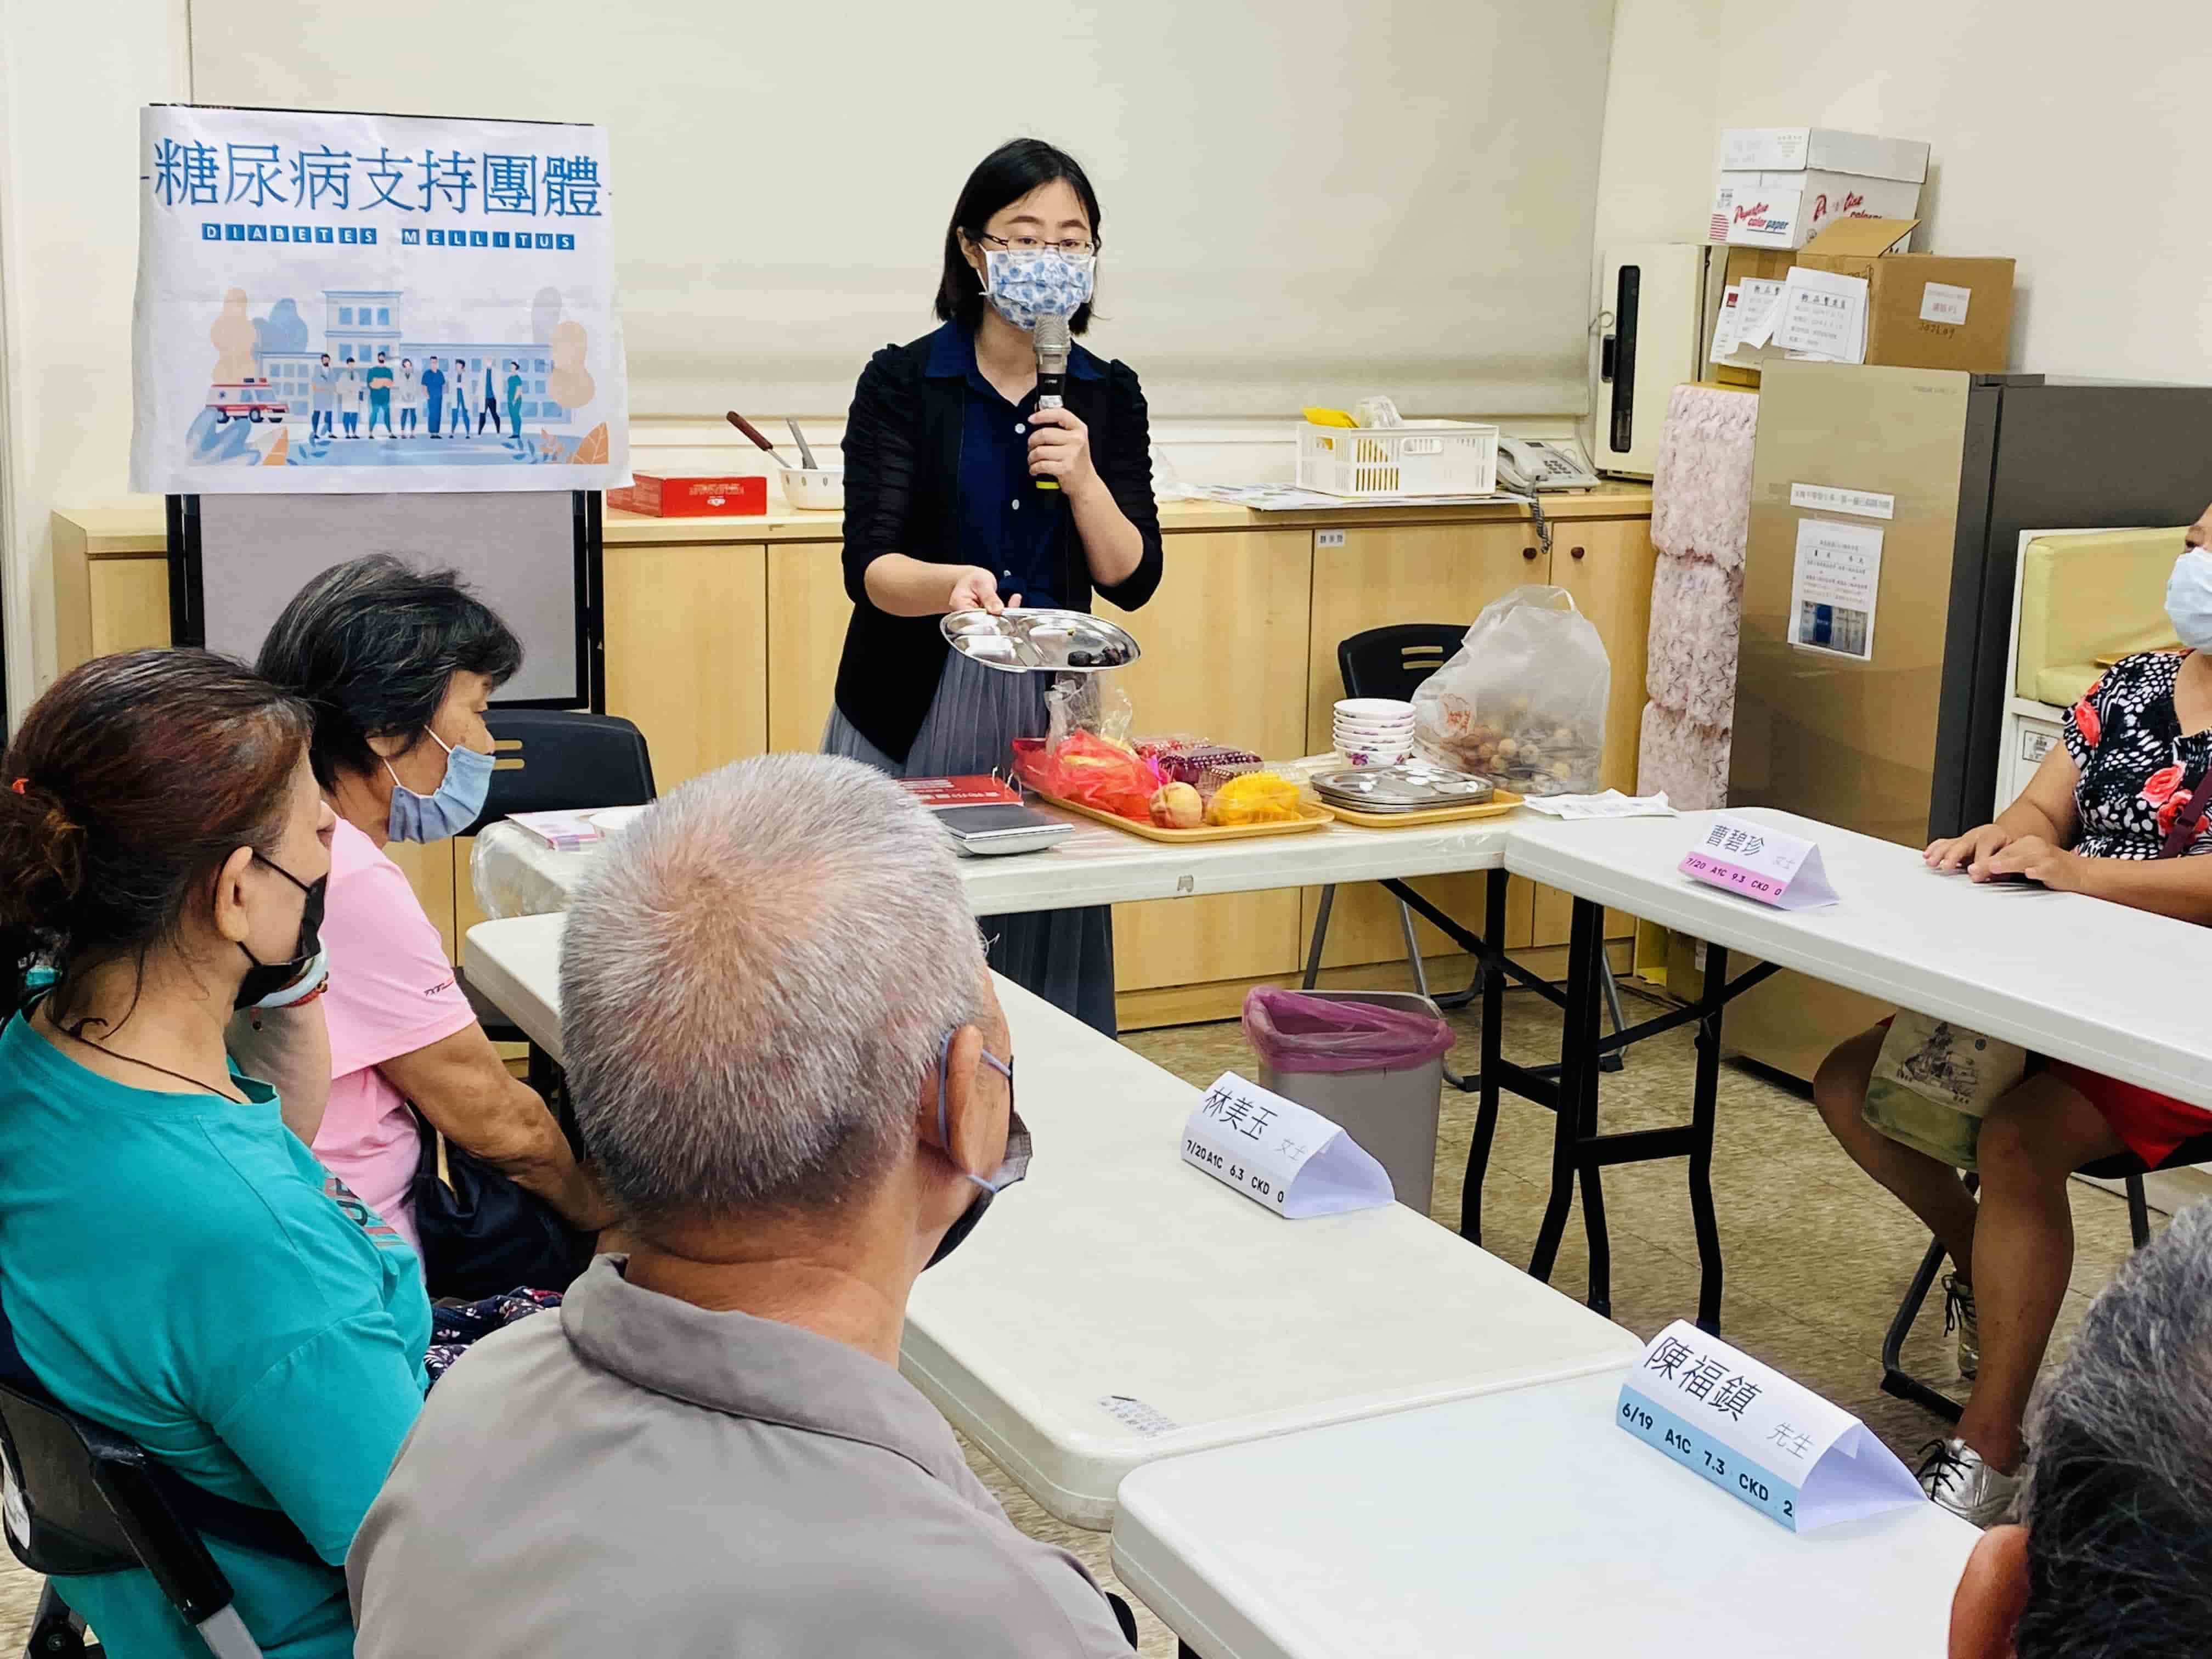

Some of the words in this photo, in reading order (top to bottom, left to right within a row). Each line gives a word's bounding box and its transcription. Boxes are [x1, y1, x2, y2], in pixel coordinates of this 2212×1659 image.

[154, 137, 602, 217] 糖尿病支持團體
[203, 224, 376, 244] DIABETES
[402, 229, 574, 250] MELLITUS
[1747, 217, 1766, 227] color
[1765, 220, 1788, 231] paper
[1685, 857, 1707, 870] 7/20
[1710, 866, 1728, 877] A1C
[1731, 873, 1746, 883] 9.3
[1751, 881, 1769, 892] CKD
[1202, 1086, 1278, 1141] 林美玉
[1274, 1137, 1308, 1161] 女士
[1229, 1164, 1244, 1181] 6.3
[1251, 1175, 1270, 1195] CKD
[1277, 1190, 1284, 1203] 0
[1643, 1336, 1763, 1422] 陳福鎮
[1766, 1421, 1816, 1460] 先生
[1621, 1403, 1654, 1431] 6/19
[1664, 1428, 1692, 1455] A1C
[1703, 1451, 1725, 1475] 7.3
[1739, 1472, 1769, 1502] CKD
[1783, 1499, 1794, 1517] 2
